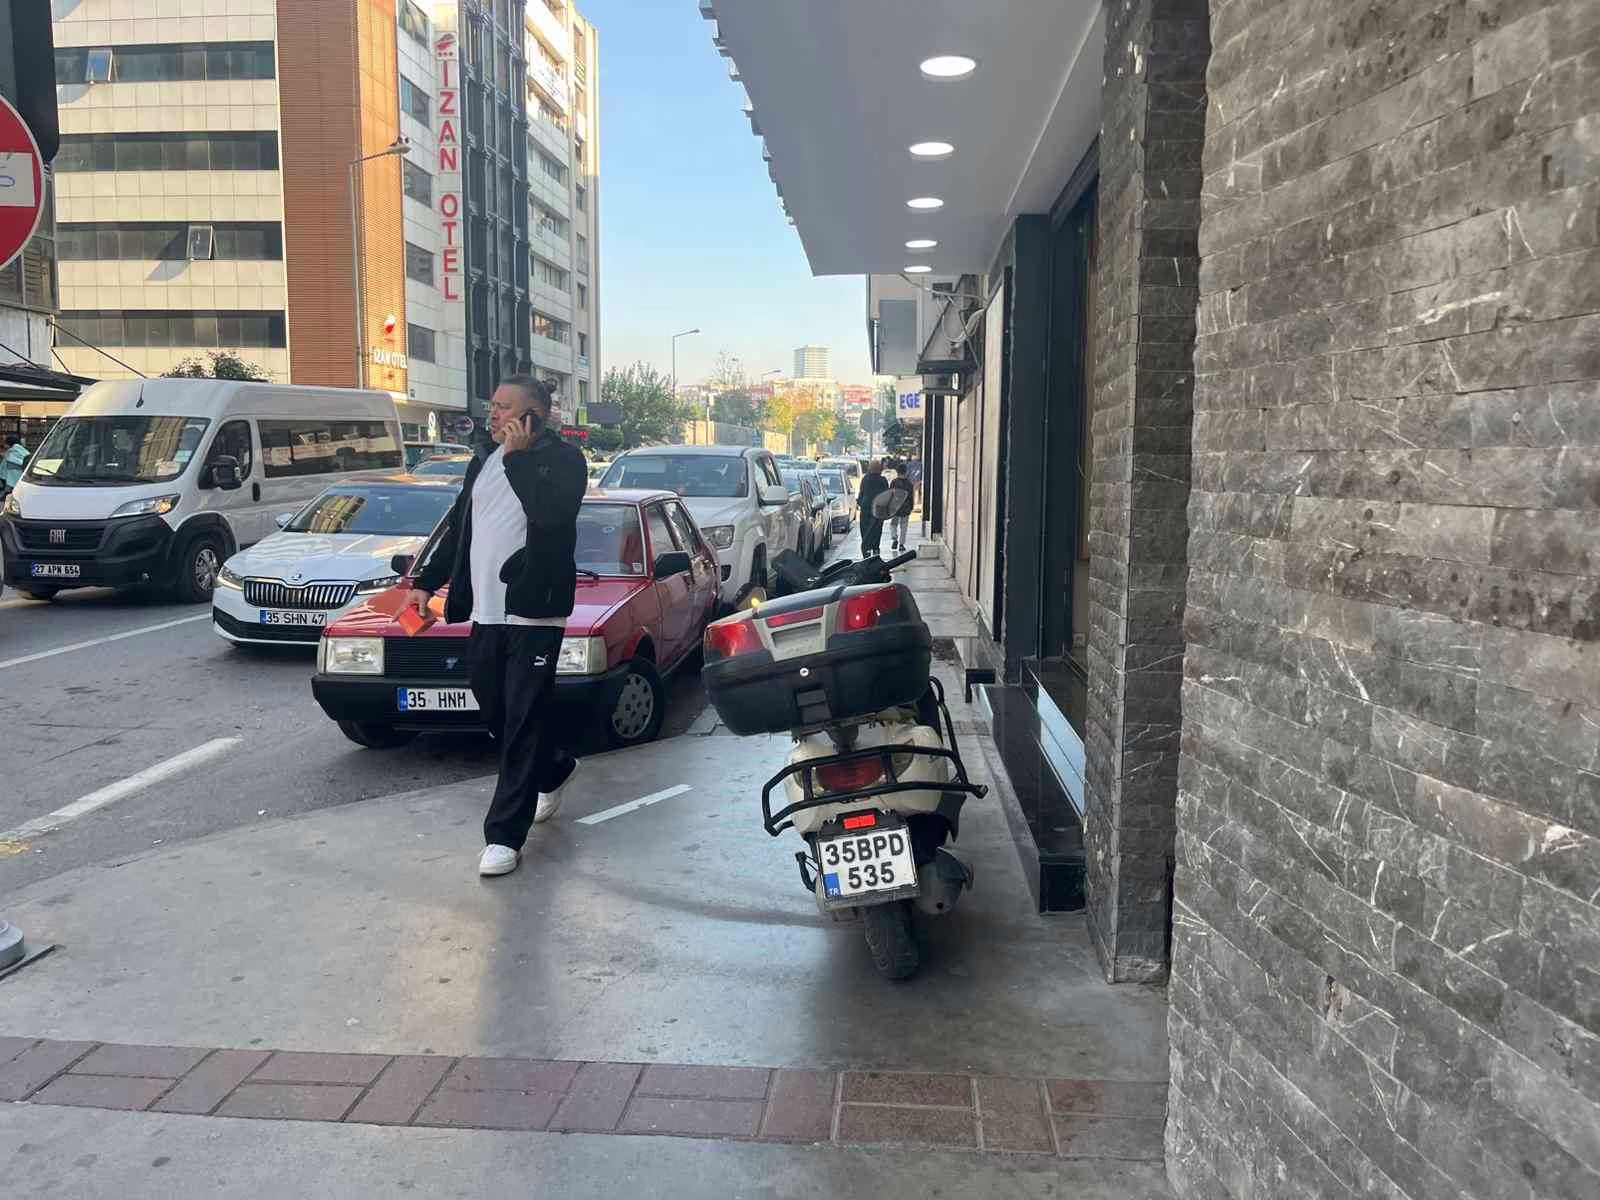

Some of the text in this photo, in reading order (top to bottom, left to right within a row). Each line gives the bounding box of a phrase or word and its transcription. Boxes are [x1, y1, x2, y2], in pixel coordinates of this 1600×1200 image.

[440, 193, 458, 300] OTEL
[899, 393, 921, 409] EGE
[36, 564, 45, 574] 27
[266, 612, 325, 625] 35 SHN 47
[408, 691, 466, 708] 35 HNM
[825, 833, 904, 865] 35BPD
[848, 861, 895, 889] 535
[828, 887, 839, 896] TR
